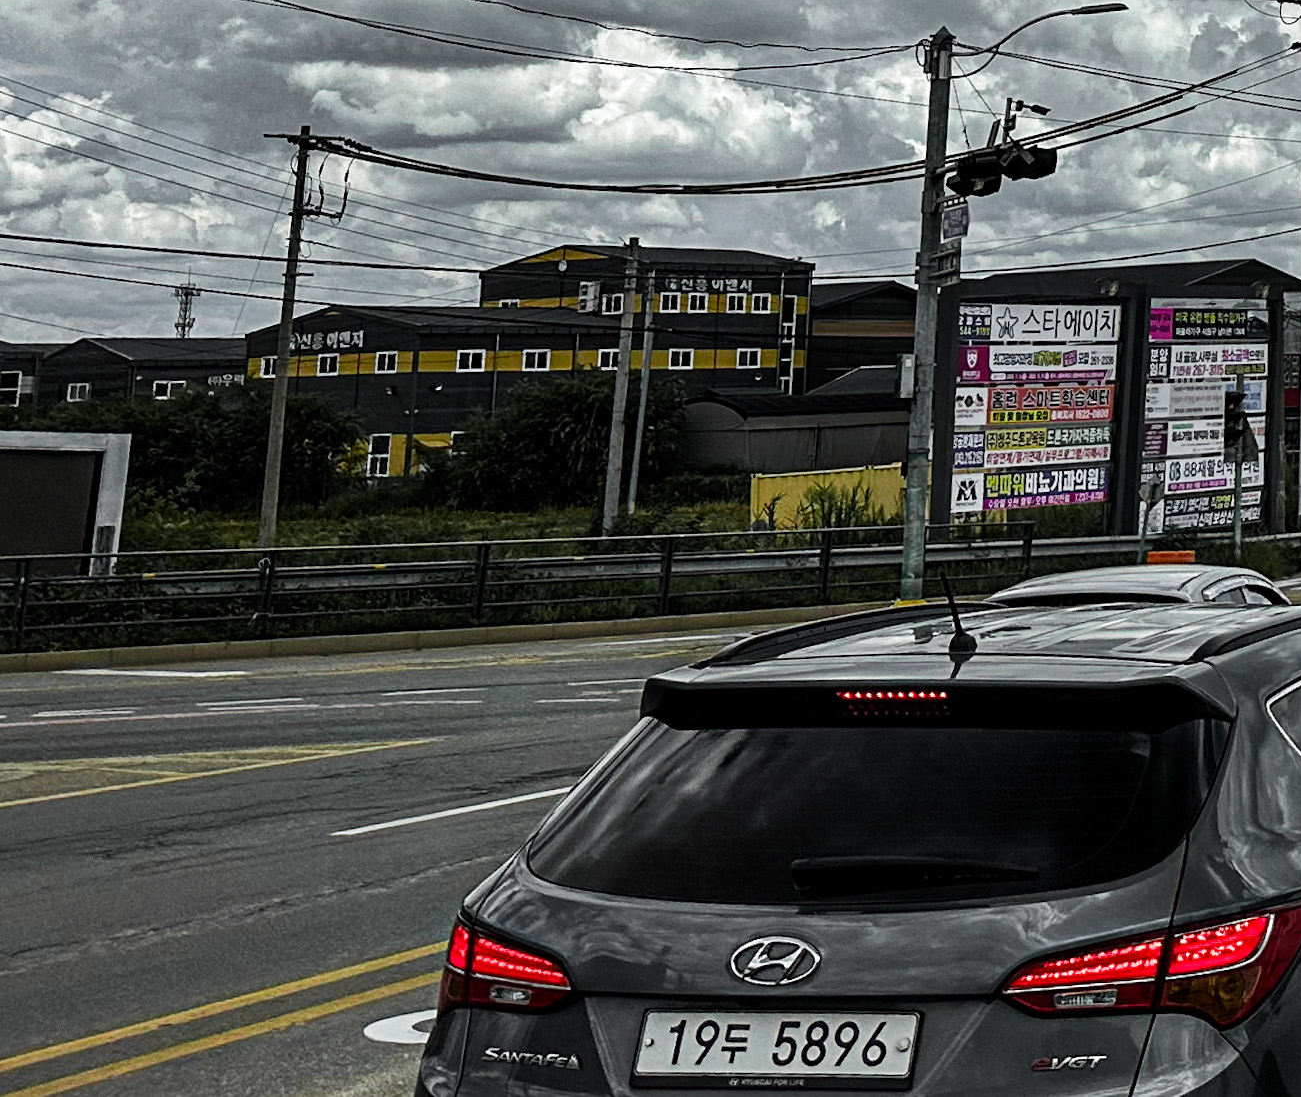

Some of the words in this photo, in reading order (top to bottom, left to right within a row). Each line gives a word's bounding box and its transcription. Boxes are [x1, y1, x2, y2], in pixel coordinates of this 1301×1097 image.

[992, 390, 1018, 409] 홈런
[1023, 387, 1111, 408] 스마트학습센터
[668, 1019, 751, 1066] 19두
[771, 1020, 888, 1067] 5896
